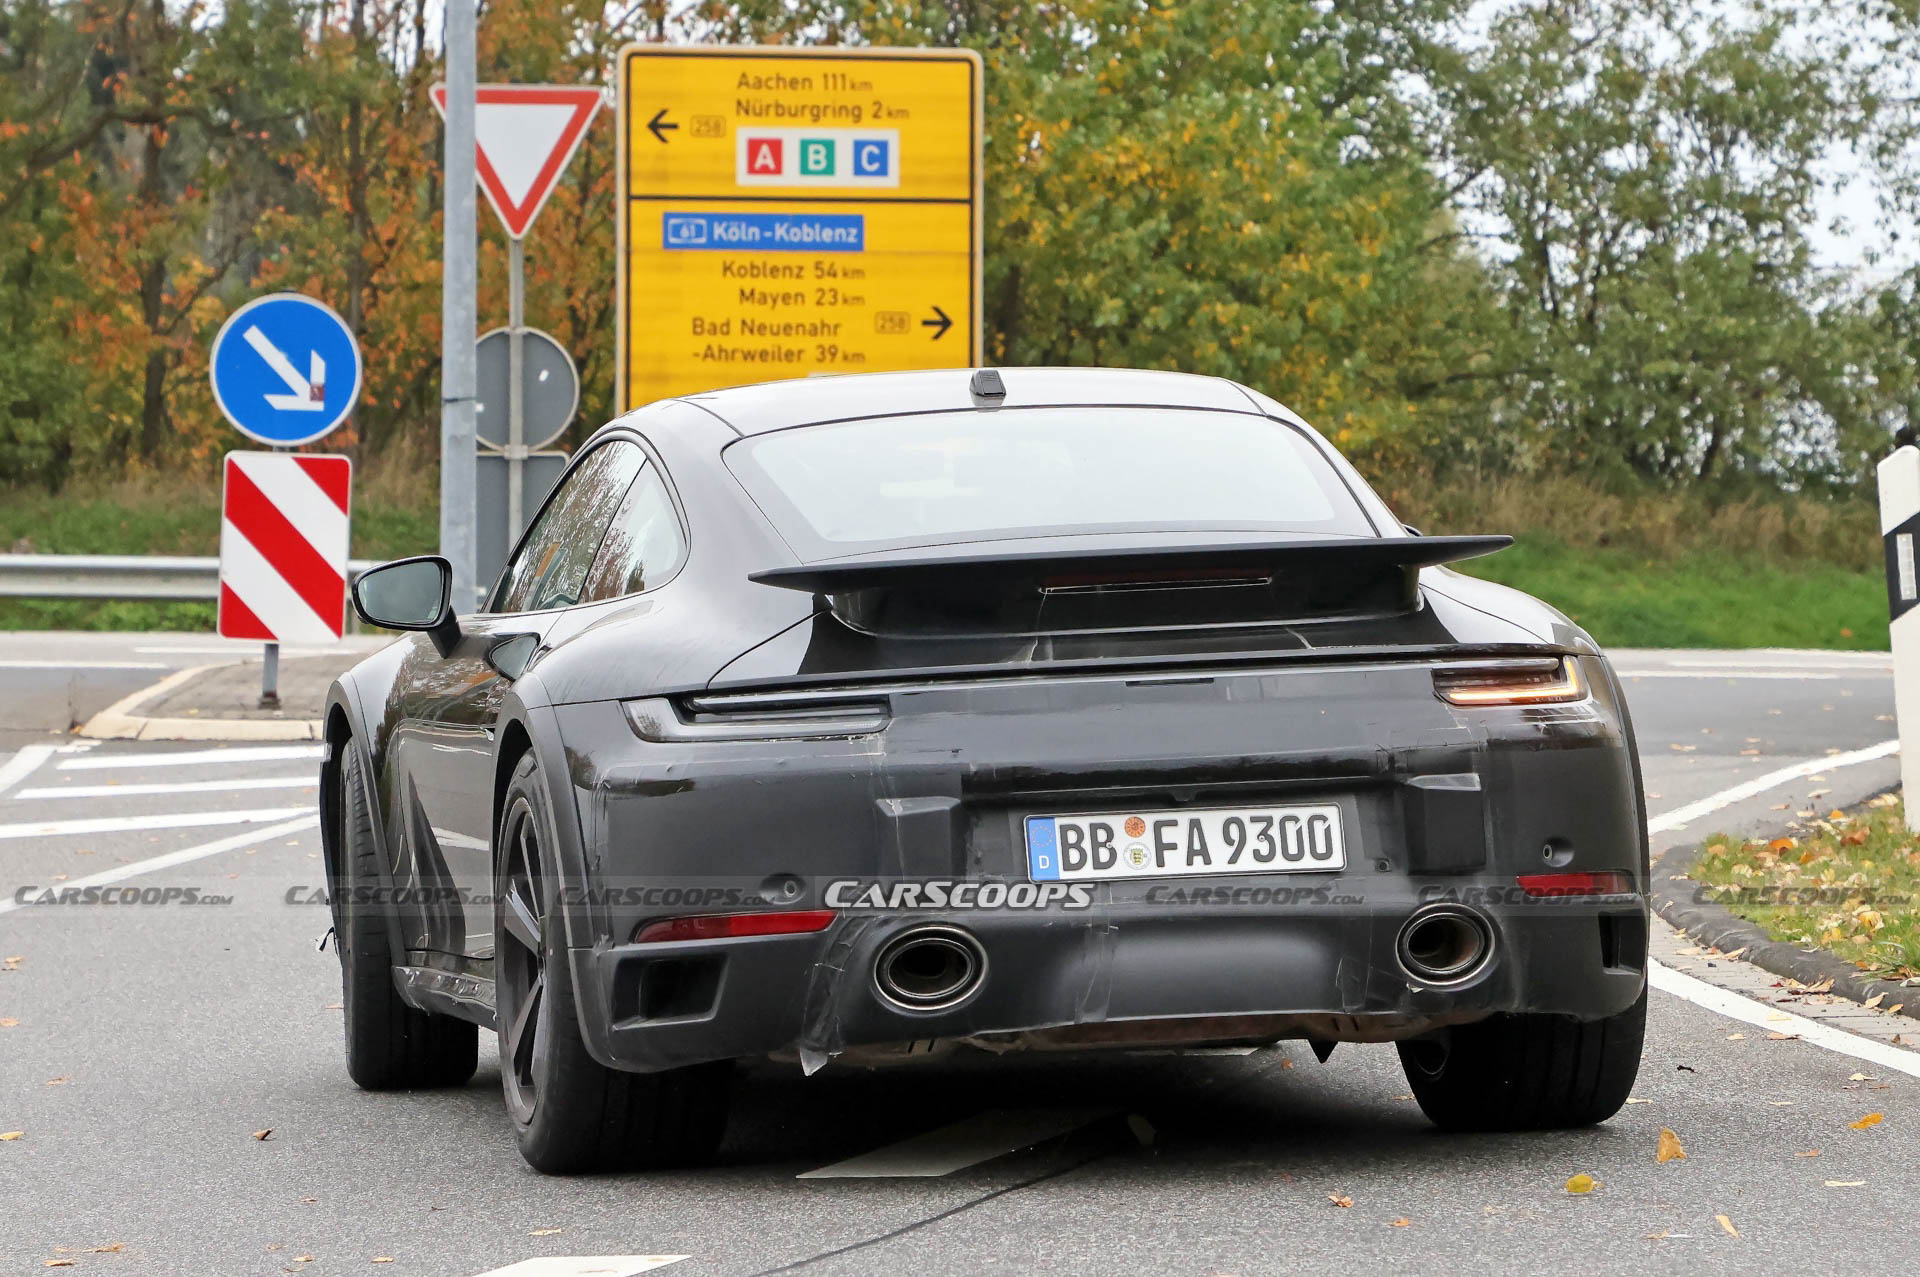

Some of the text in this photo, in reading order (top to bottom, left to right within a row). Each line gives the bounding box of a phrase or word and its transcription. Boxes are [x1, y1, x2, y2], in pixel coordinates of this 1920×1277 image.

[736, 72, 873, 92] Aachen 111 km
[736, 99, 910, 123] Nürburgring 2 km
[754, 143, 881, 172] A B C
[680, 222, 695, 238] 61
[721, 260, 866, 279] Koblenz 54 km
[738, 288, 866, 310] Mayen 23 km
[691, 317, 842, 337] Bad Neuenahr
[691, 344, 866, 363] -Ahrweiler 39 km
[1058, 822, 1118, 872] BB
[1153, 818, 1212, 868] FA
[1222, 814, 1333, 865] 9300
[1038, 855, 1050, 870] D
